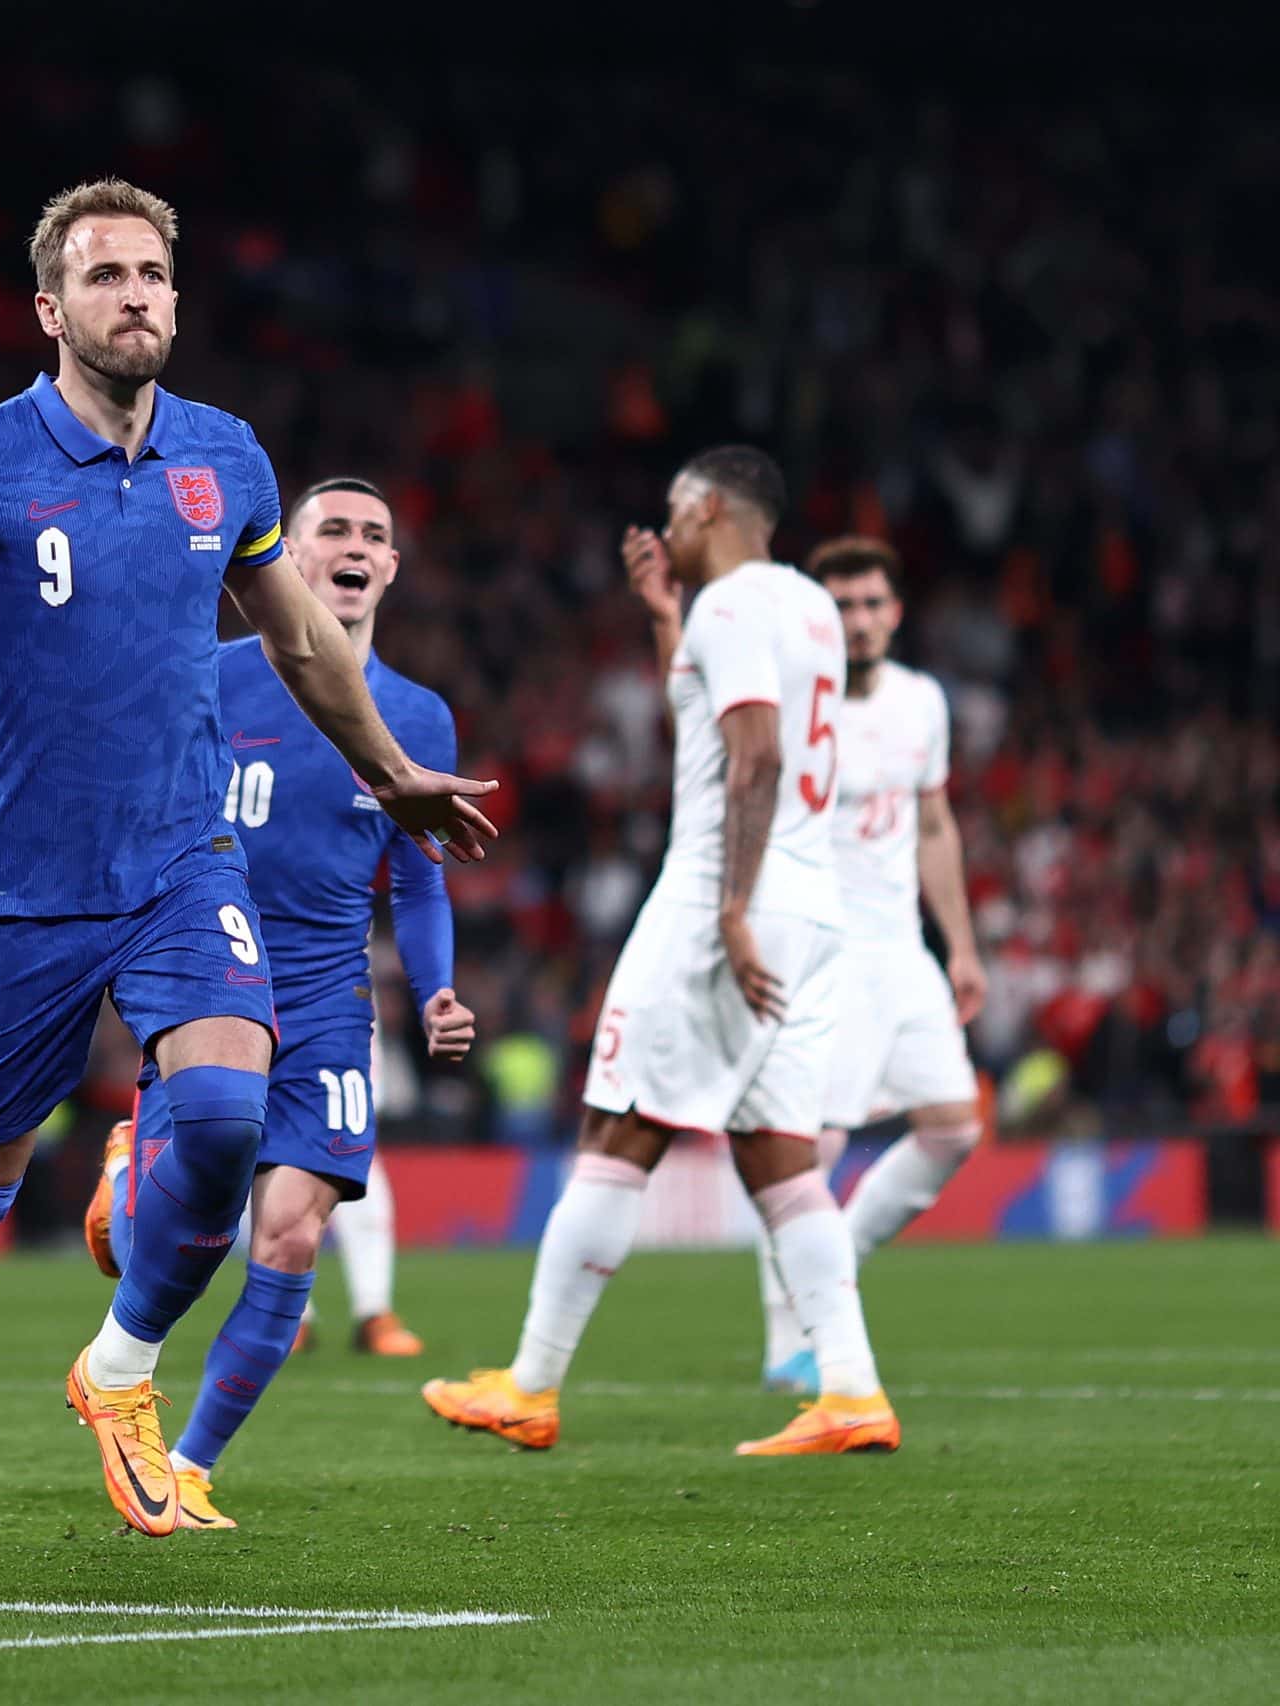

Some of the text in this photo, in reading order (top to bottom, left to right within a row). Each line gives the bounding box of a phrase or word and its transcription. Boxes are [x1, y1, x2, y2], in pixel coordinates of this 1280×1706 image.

[36, 526, 73, 607] 9
[799, 675, 837, 814] 5
[223, 758, 275, 829] 10
[218, 904, 259, 965] 9
[598, 1007, 627, 1062] 5
[319, 1068, 368, 1135] 10
